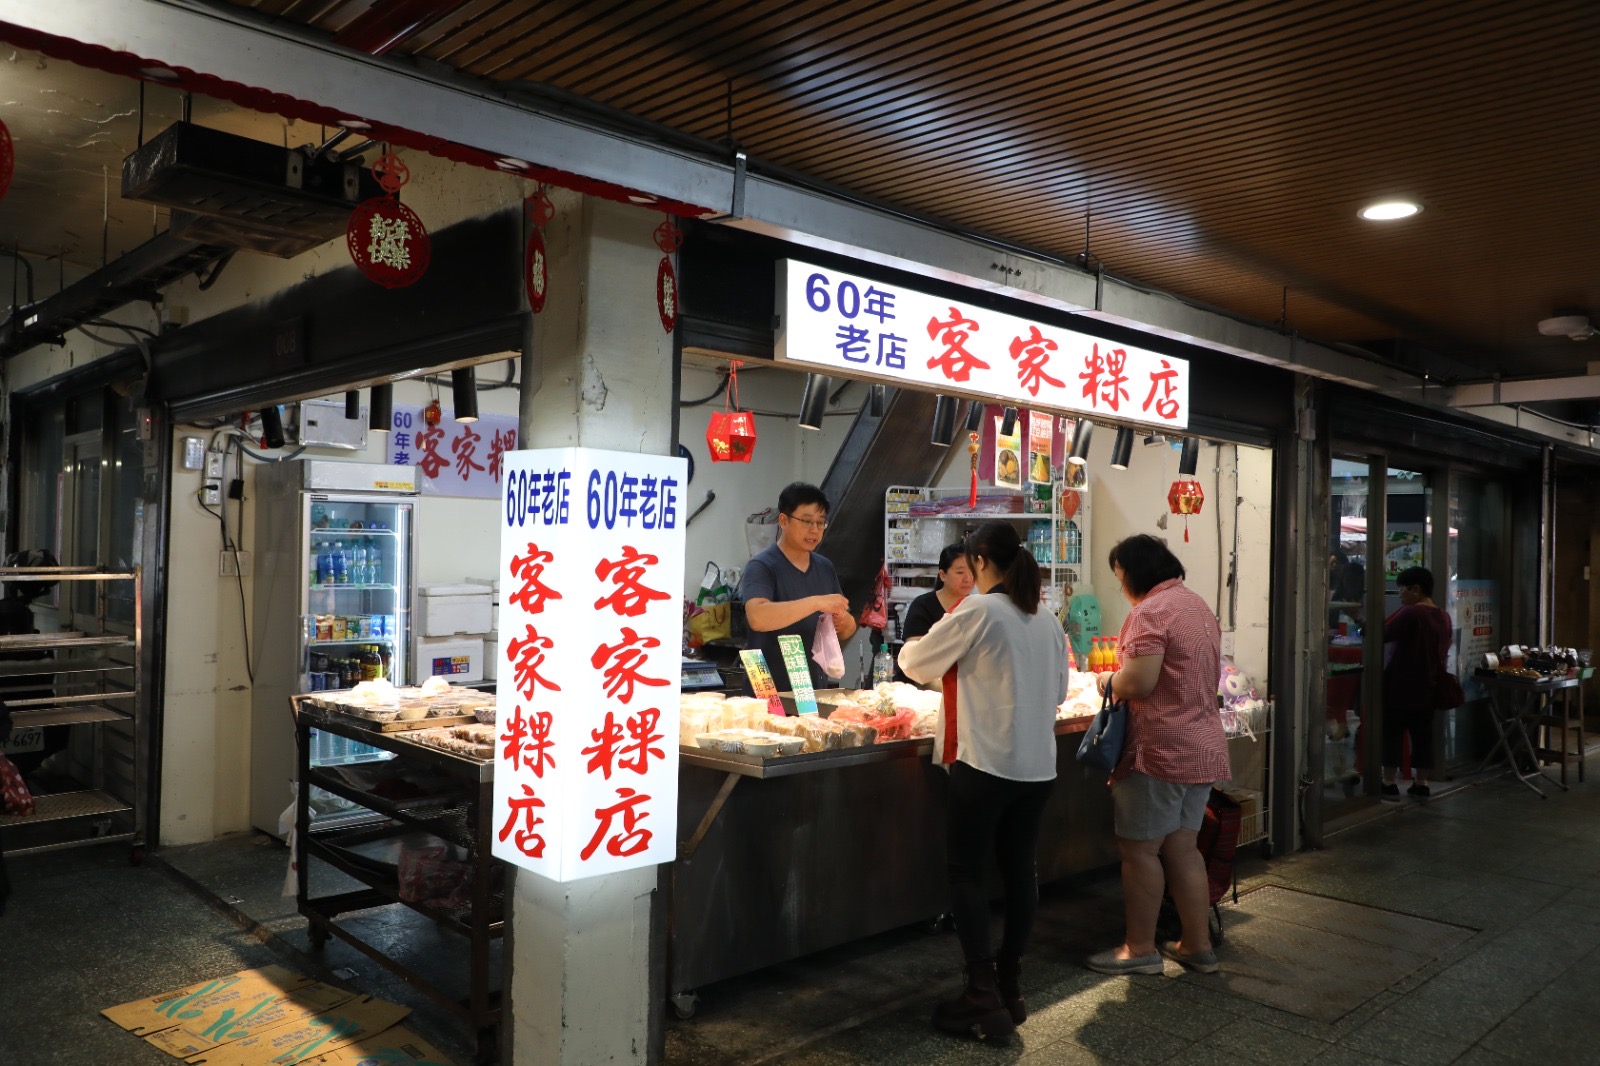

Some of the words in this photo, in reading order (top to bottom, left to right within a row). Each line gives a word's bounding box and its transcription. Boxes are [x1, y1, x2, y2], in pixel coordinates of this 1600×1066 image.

[805, 273, 896, 324] 60年
[835, 323, 908, 370] 老店
[926, 306, 1180, 421] 客家粿店
[506, 466, 572, 527] 60年老店
[586, 468, 678, 531] 60年老店
[498, 542, 563, 860] 客家粿店
[580, 545, 672, 862] 客家粿店
